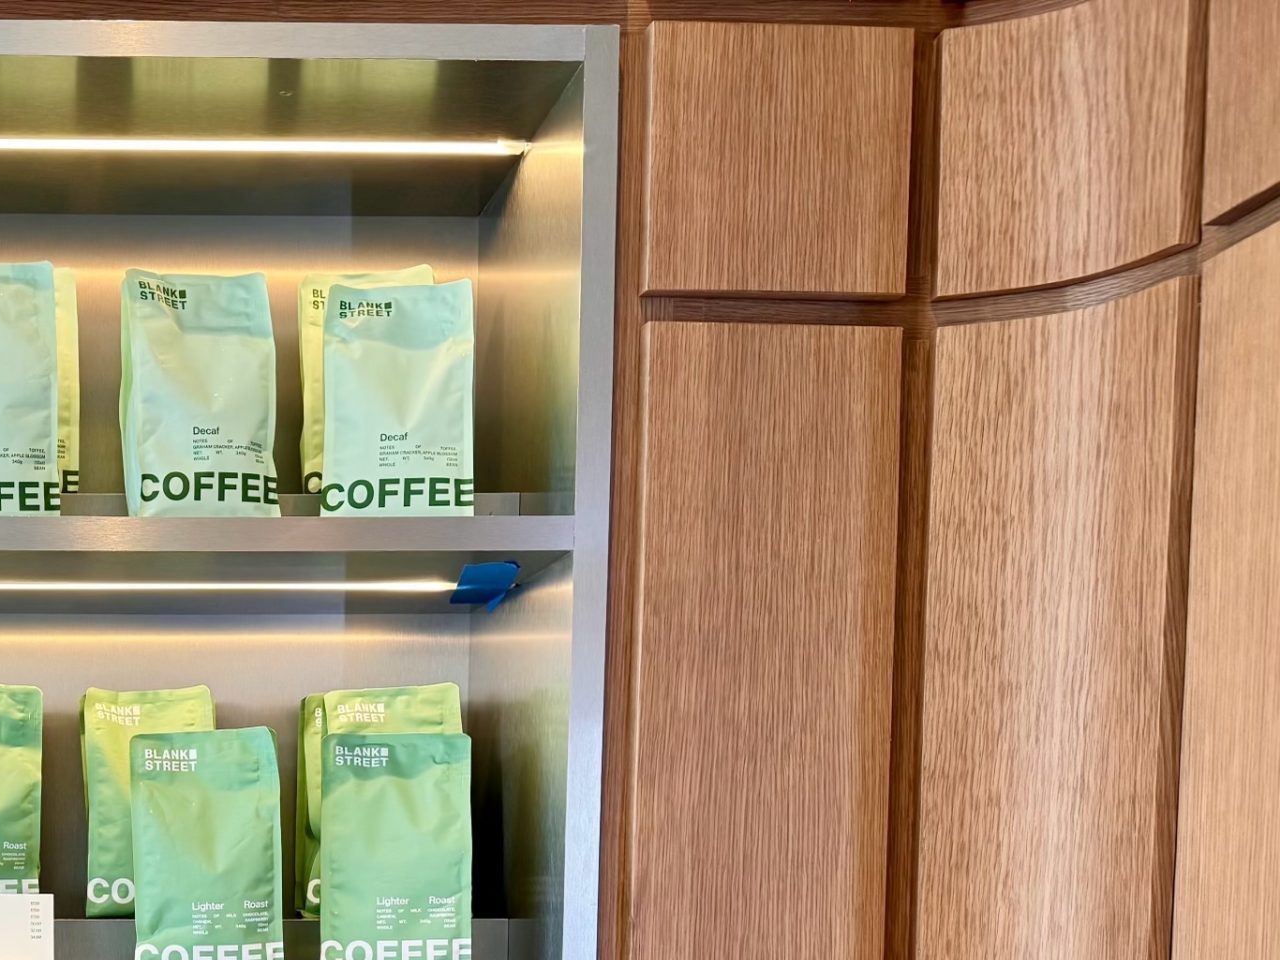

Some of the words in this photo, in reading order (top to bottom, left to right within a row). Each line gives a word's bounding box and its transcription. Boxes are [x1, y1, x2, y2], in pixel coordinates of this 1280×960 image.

[138, 280, 178, 299] BLANK
[140, 290, 187, 310] STREET
[339, 300, 383, 311] BLANK
[339, 309, 393, 319] STREET
[192, 426, 220, 435] Decaf
[380, 432, 408, 442] Decaf
[140, 471, 280, 505] COFFEE
[320, 478, 473, 512] COFFEE
[95, 702, 133, 714] BLANK
[337, 703, 376, 713] BLANK
[97, 711, 141, 726] STREET
[339, 712, 385, 723] STREET
[145, 749, 188, 760] BLANK
[336, 746, 380, 757] BLANK
[145, 760, 197, 772] STREET
[335, 756, 389, 767] STREET
[3, 841, 27, 850] Roast
[192, 902, 224, 912] Lighter
[244, 900, 269, 909] Roast
[376, 897, 409, 907] Lighter
[428, 896, 455, 905] Roast
